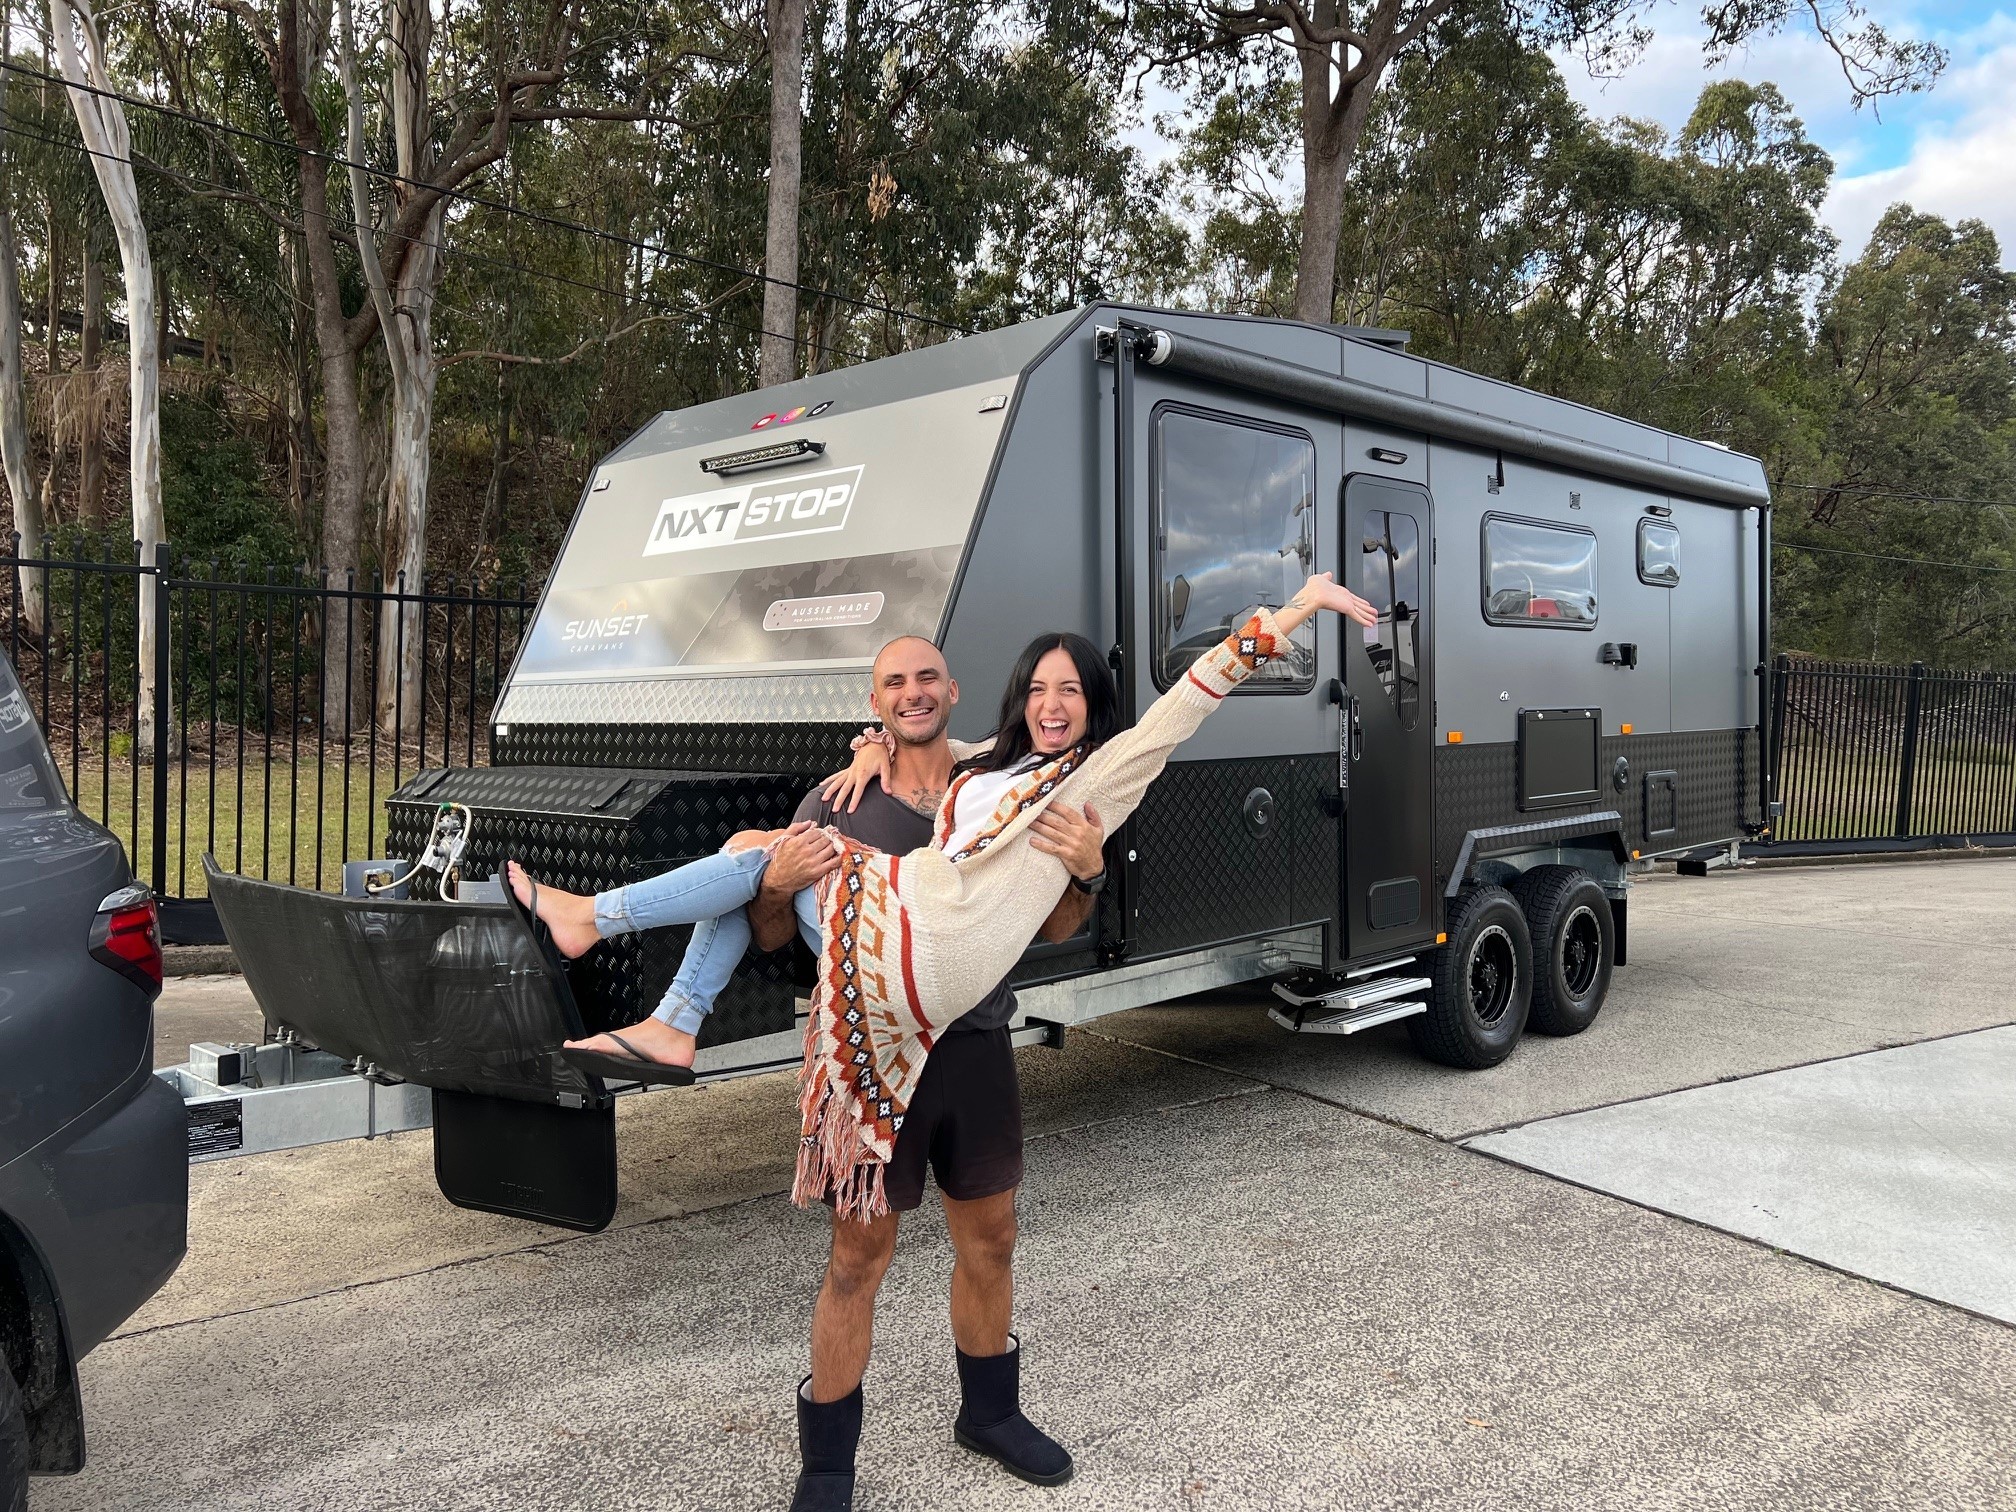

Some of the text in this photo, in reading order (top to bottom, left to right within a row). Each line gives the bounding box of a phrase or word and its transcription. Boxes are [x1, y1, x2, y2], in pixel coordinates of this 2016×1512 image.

[654, 483, 851, 541] NXT STOP
[791, 602, 870, 616] AUSSIE MADE
[561, 614, 648, 640] SUNSET
[570, 642, 624, 653] CARAVANS
